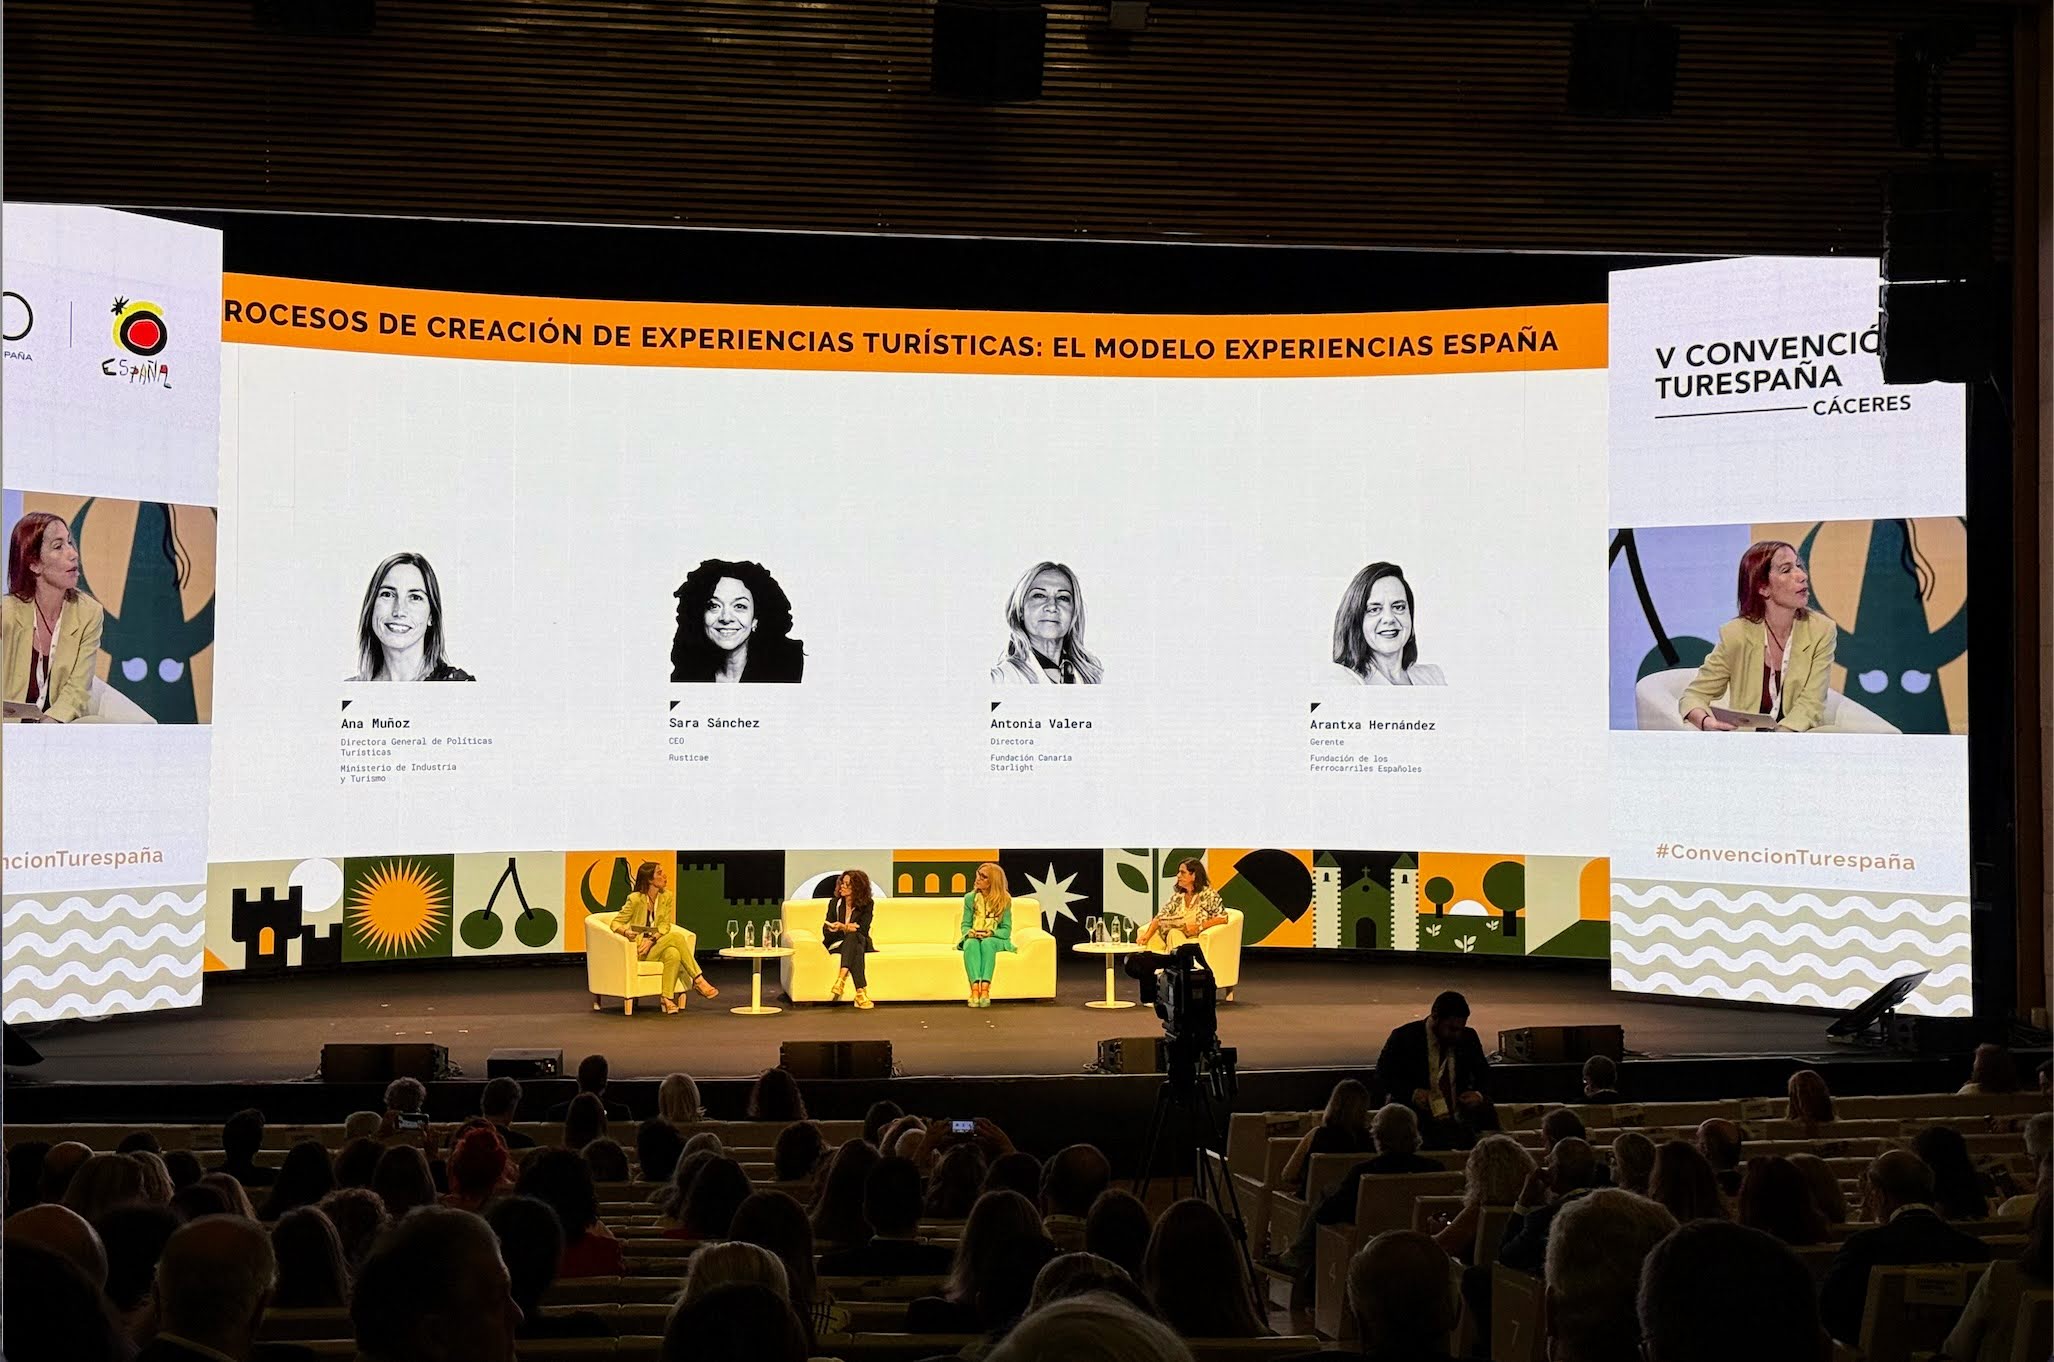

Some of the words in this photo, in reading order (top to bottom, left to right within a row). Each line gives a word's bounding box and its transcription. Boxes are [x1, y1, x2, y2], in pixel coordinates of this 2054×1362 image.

[224, 299, 368, 333] ROCESOS
[379, 312, 417, 337] DE
[427, 316, 582, 346] CREACIÓN
[593, 324, 631, 347] DE
[642, 326, 854, 353] EXPERIENCIAS
[862, 328, 1042, 357] TURÍSTICAS:
[1053, 337, 1086, 358] EL
[1095, 338, 1215, 360] MODELO
[1225, 335, 1433, 360] EXPERIENCIAS
[1444, 326, 1559, 355] ESPAÑA
[1655, 346, 1676, 369] V
[101, 358, 172, 389] ESPAÑA
[1655, 361, 1843, 399] TURESPAÑA
[1812, 394, 1912, 416] CÁCERES
[341, 718, 364, 730] Ana
[372, 717, 411, 730] Muñoz
[669, 717, 700, 729] Sara
[707, 717, 761, 729] Sánchez
[990, 718, 1042, 730] Antonia
[1049, 718, 1093, 730] Valera
[1310, 720, 1362, 731] Arantxa
[1369, 719, 1436, 732] Hernández
[340, 738, 387, 747] Directora
[391, 736, 427, 746] General
[431, 737, 443, 746] de
[446, 736, 493, 745] Políticas
[668, 736, 685, 745] CEO
[990, 738, 1035, 746] Directora
[1310, 737, 1345, 746] Gerente
[668, 753, 710, 762] Rusticae
[990, 753, 1035, 762] Fundación
[1038, 753, 1073, 762] Canaria
[1310, 754, 1355, 763] Fundación
[1358, 754, 1369, 763] de
[1373, 754, 1389, 763] los
[340, 764, 392, 773] Ministerio
[395, 763, 407, 772] de
[411, 762, 457, 772] Industria
[990, 763, 1034, 773] Starlight
[1310, 764, 1374, 773] Ferrocarriles
[1377, 764, 1422, 775] Españoles
[340, 777, 346, 785] y
[351, 774, 387, 783] Turismo
[1655, 843, 1916, 872] #ConvencionTurespaña
[1511, 1319, 1521, 1345] 7
